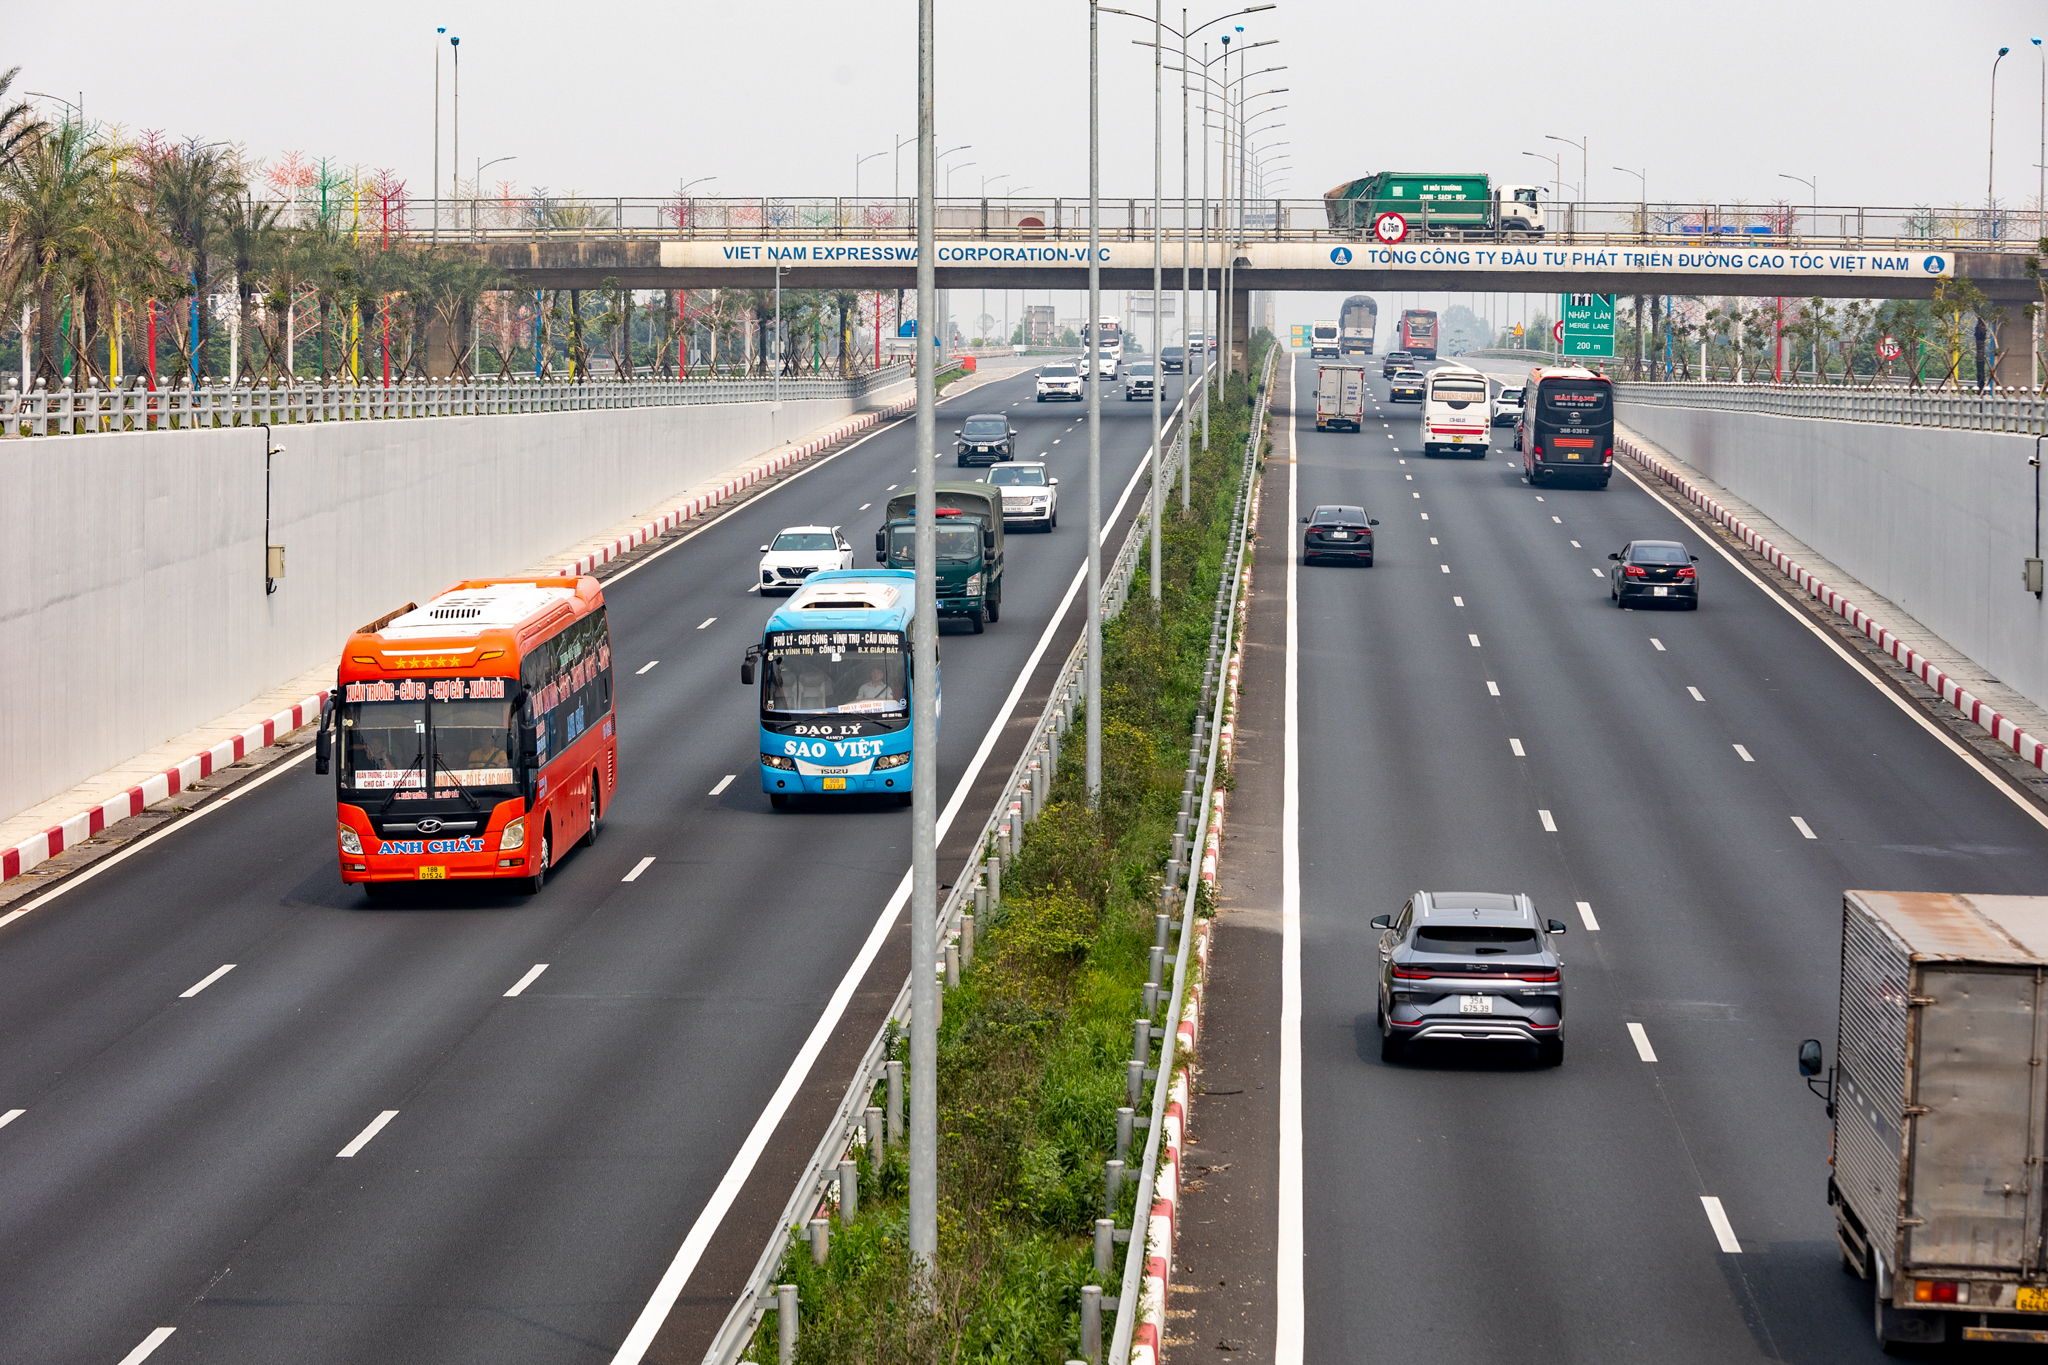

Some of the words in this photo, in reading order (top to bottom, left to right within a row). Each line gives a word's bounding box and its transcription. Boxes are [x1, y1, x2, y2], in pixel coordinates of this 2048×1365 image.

[723, 246, 762, 260] VIET
[768, 246, 807, 260] NAM
[813, 247, 918, 261] EXPRESSWA
[938, 247, 1111, 262] CORPORATION-VC
[1368, 247, 1416, 264] TỔNG
[1420, 247, 1470, 264] CÔNG
[1475, 251, 1497, 265] TY
[1501, 248, 1537, 265] ĐẦU
[1543, 252, 1567, 265] TƯ
[1572, 250, 1618, 266] PHÁT
[1623, 250, 1673, 267] TRIỂN
[1678, 250, 1743, 269] ĐƯỜNG
[1748, 254, 1784, 269] CAO
[1789, 252, 1824, 269] TỐC
[1829, 254, 1866, 272] VIỆT
[1872, 257, 1909, 271] NAM
[1568, 310, 1590, 320] NHẬP
[1594, 310, 1611, 320] LÀN
[1577, 342, 1590, 350] 200
[786, 633, 794, 646] LÝ
[798, 634, 811, 648] CHỢ
[848, 633, 860, 646] TRỤ
[878, 632, 899, 645] KHÔNG
[801, 647, 814, 656] TRỤ
[870, 645, 885, 654] GIÁP
[886, 645, 899, 654] BÁT
[346, 680, 365, 703] XUÂN
[366, 679, 394, 701] TRƯỜNG
[416, 682, 426, 700] 50
[434, 680, 450, 703] CHỢ
[450, 677, 464, 699] CÁT
[469, 676, 490, 699] XUÂN
[491, 676, 504, 699] ĐÀI
[795, 725, 833, 737] ĐẠO
[840, 723, 862, 735] LÝ
[784, 740, 827, 758] SAO
[833, 738, 884, 759] VIỆT
[375, 779, 385, 787] CÁT
[378, 841, 423, 855] ANH
[427, 834, 485, 853] CHẤT
[1469, 996, 1483, 1004] 35A
